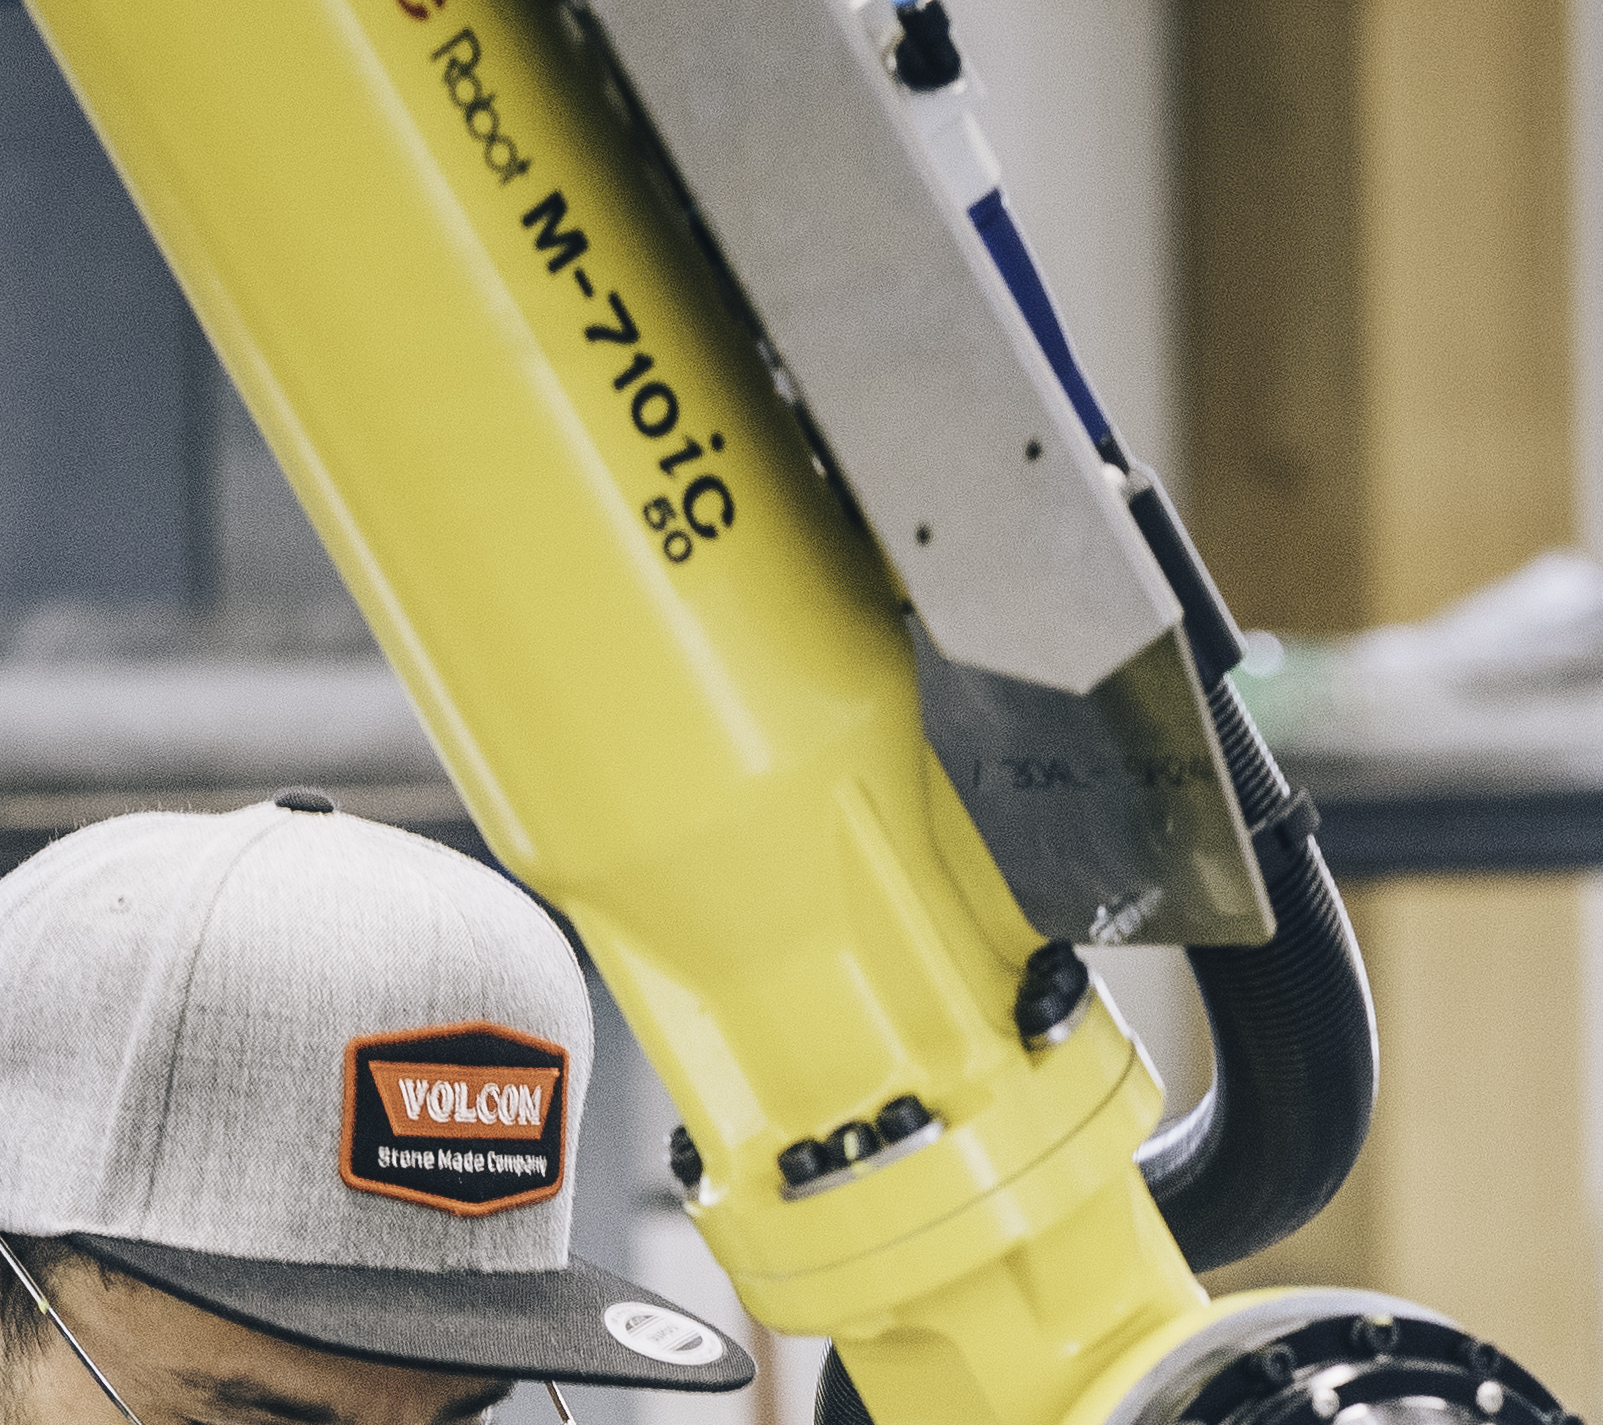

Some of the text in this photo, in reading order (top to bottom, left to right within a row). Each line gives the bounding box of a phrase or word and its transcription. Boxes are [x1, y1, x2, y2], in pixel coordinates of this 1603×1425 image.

[430, 27, 735, 540] Robot M-710iC
[643, 496, 694, 564] 50
[377, 1146, 548, 1178] Stone Made Company
